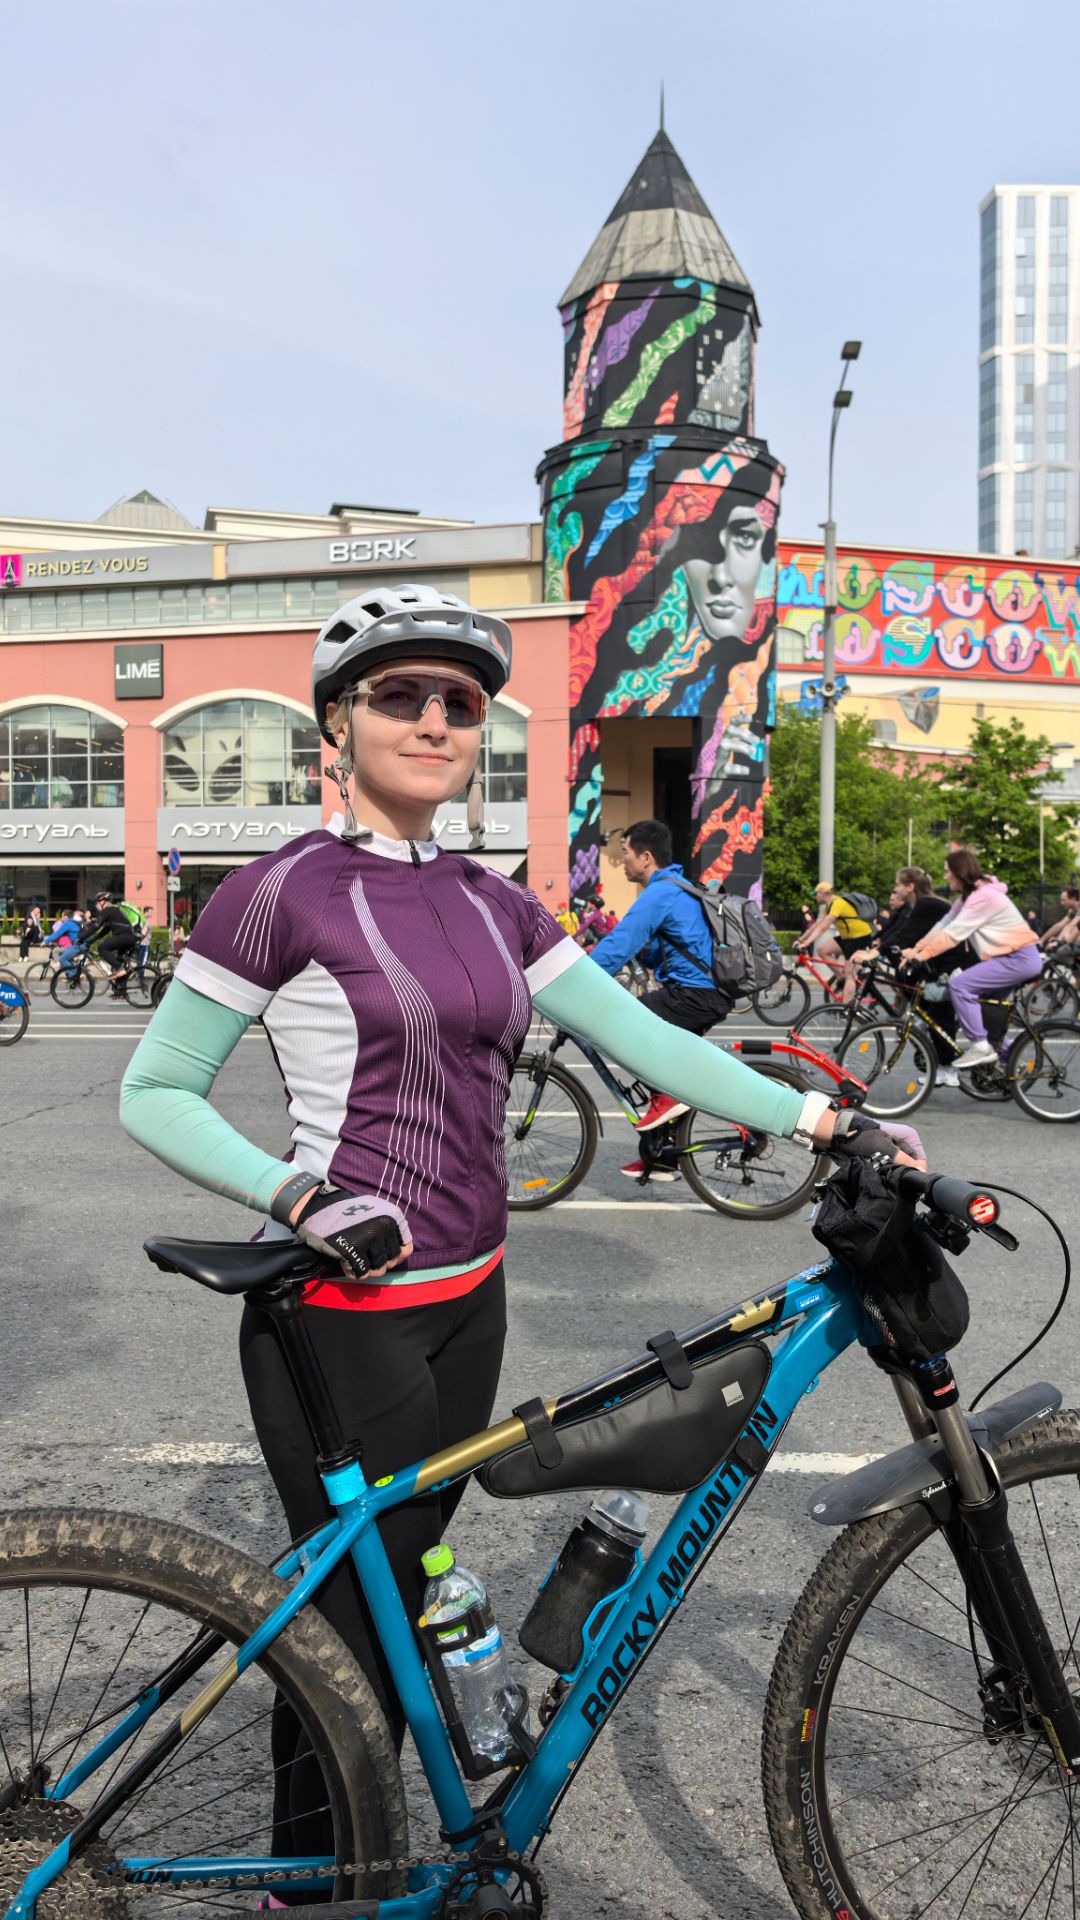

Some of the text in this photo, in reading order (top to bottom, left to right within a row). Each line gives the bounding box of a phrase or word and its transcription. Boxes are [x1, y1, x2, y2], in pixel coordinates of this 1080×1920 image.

[329, 537, 416, 563] BORK
[0, 823, 109, 842] этуаль
[580, 1398, 779, 1730] ROCKY MOUNTIN
[813, 1594, 861, 1686] KRAKEN
[800, 1770, 842, 1909] HUTCHINSON
